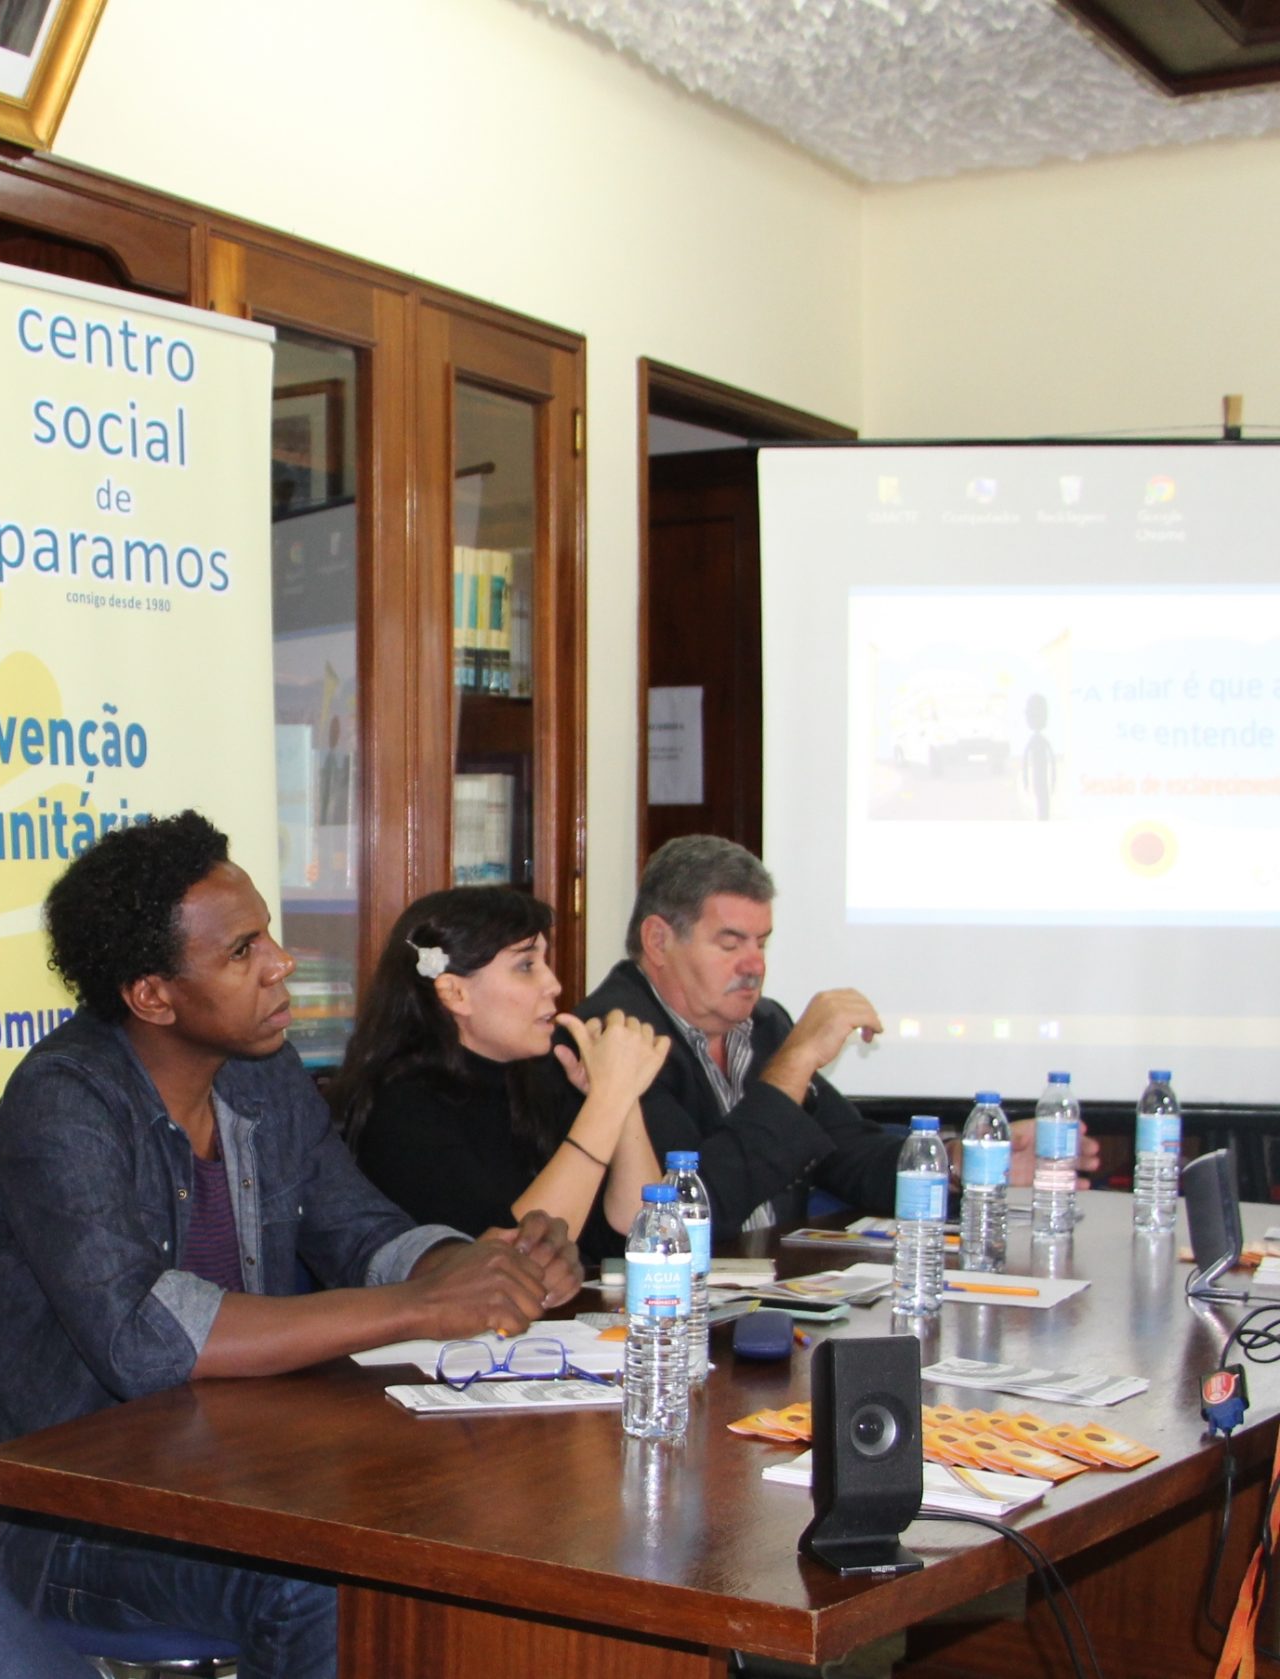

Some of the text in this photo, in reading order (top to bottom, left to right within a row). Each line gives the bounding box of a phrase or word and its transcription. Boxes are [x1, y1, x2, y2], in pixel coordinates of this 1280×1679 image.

[18, 307, 195, 382] centro
[33, 399, 186, 466] social
[96, 478, 131, 513] de
[66, 590, 171, 613] consigo desde 1980
[1112, 674, 1173, 704] falar
[1183, 668, 1200, 699] é
[1208, 676, 1265, 707] que
[1116, 717, 1276, 749] se entende
